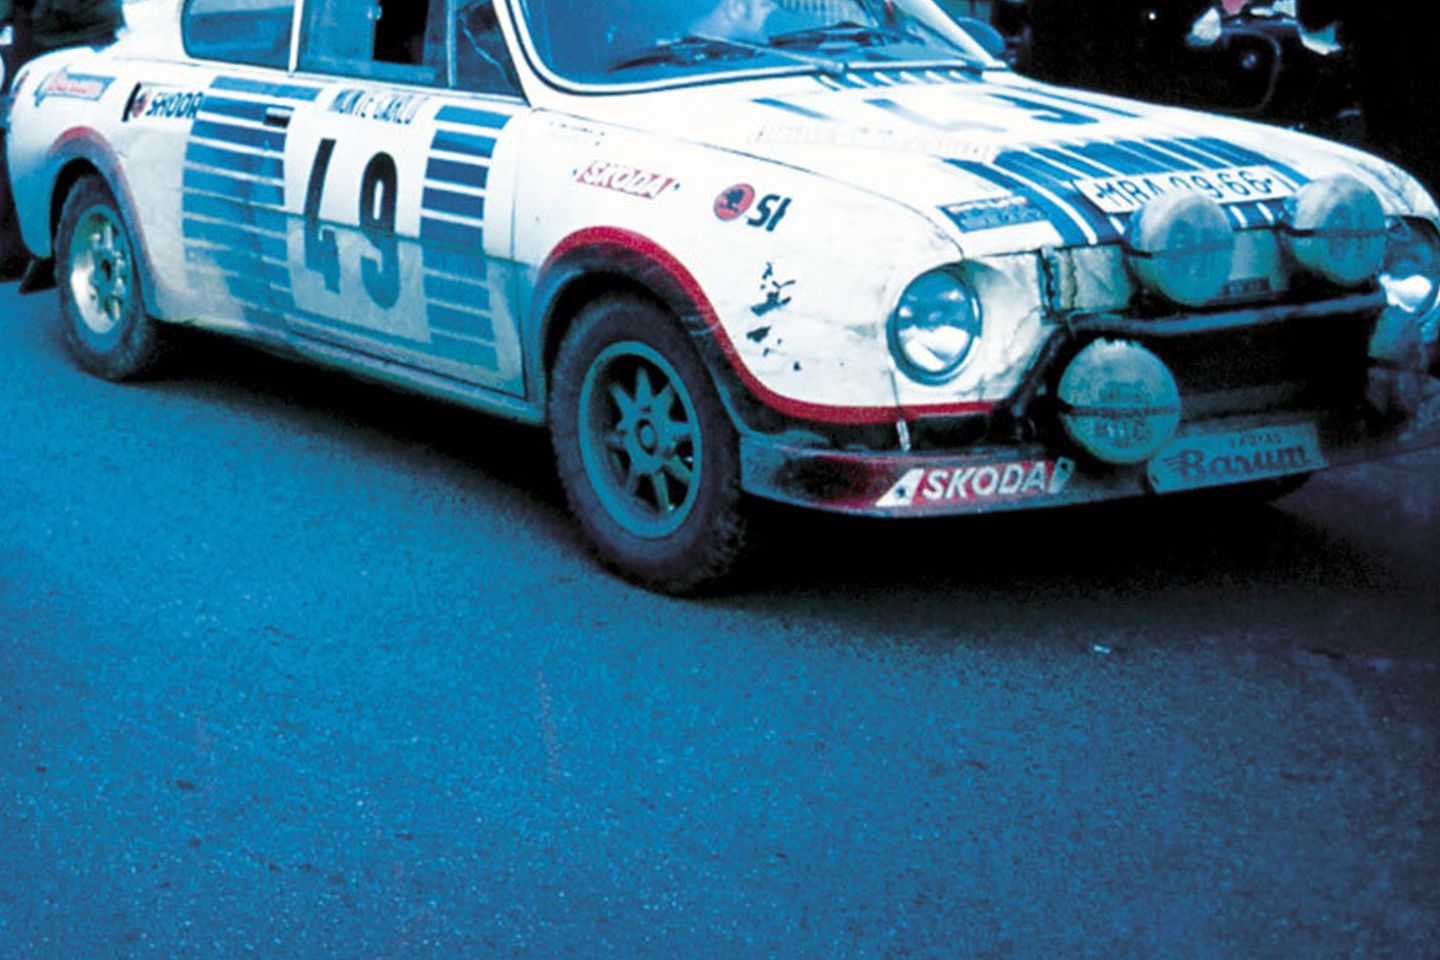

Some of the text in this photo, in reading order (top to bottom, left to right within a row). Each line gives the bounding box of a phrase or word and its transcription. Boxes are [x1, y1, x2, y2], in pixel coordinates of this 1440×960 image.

[303, 137, 401, 311] 49
[921, 460, 1045, 501] SKODA
[1168, 444, 1307, 480] Barum
